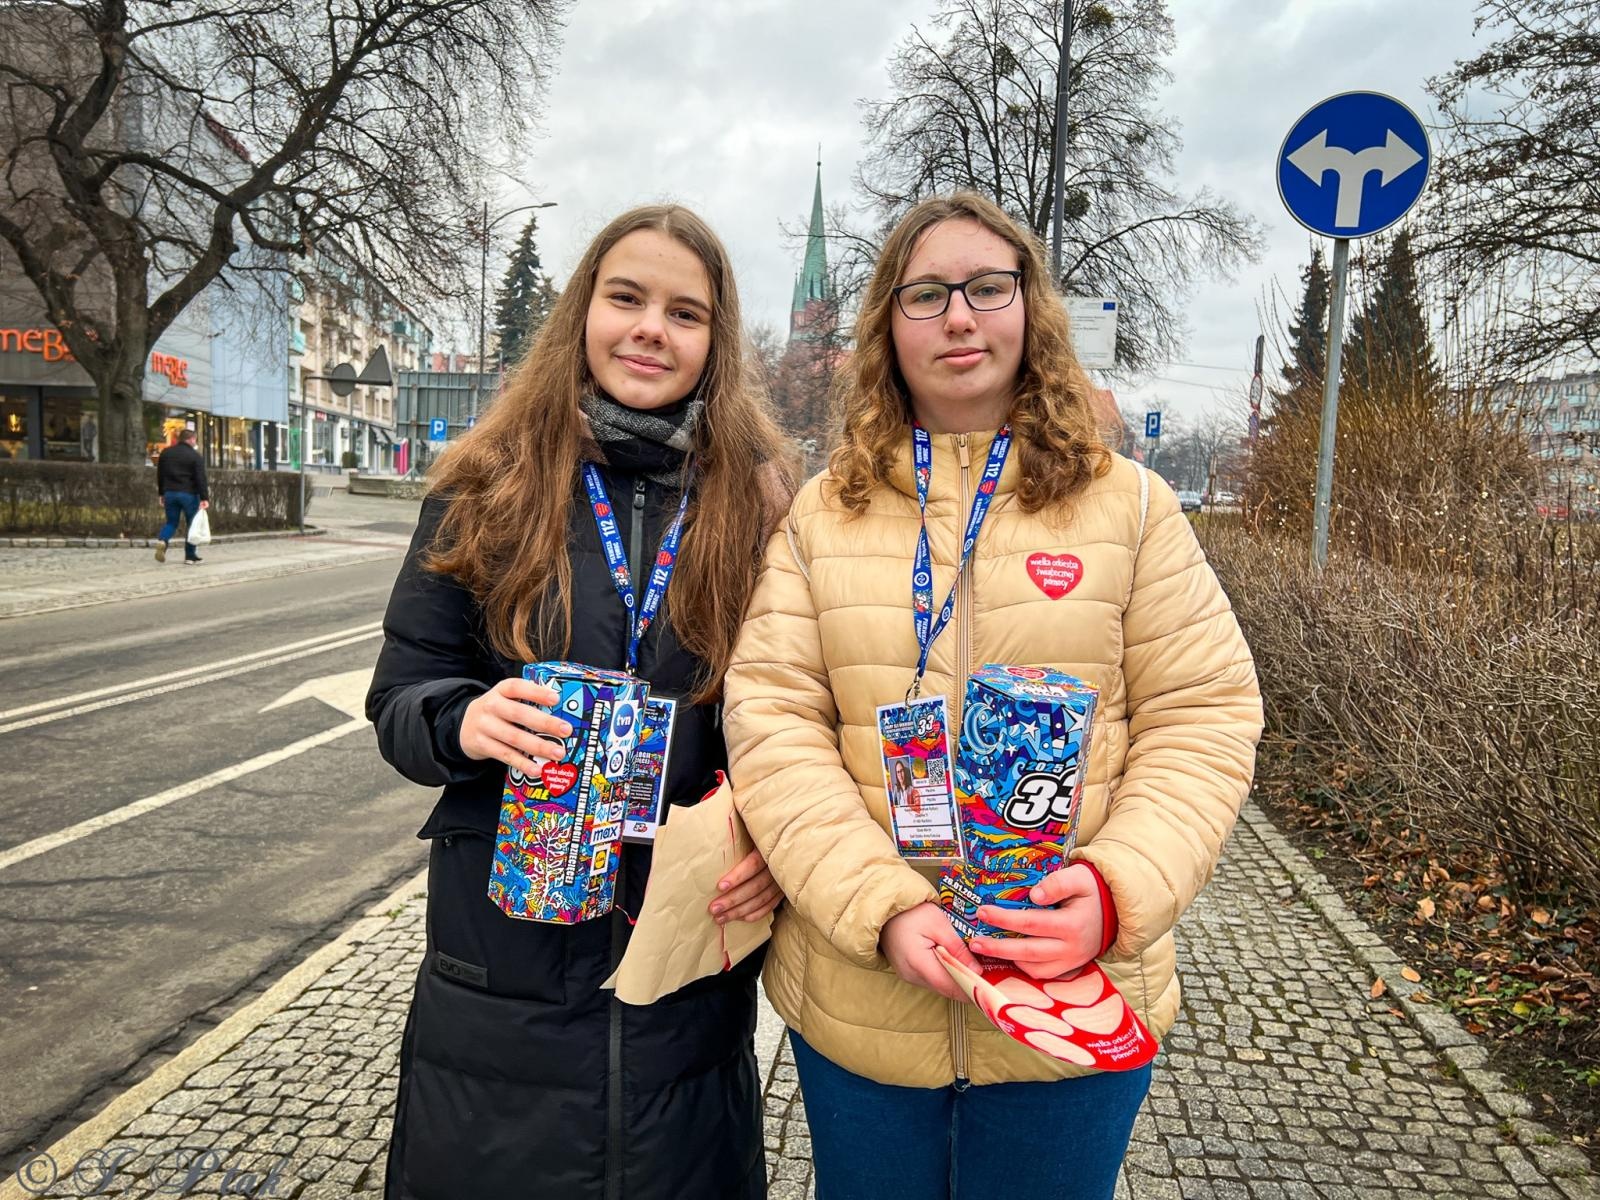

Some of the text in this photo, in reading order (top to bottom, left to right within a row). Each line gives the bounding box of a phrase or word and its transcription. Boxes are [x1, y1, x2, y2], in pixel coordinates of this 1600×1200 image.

[433, 420, 444, 435] P
[1148, 414, 1159, 435] P
[984, 463, 1001, 478] 112
[600, 519, 616, 538] 112
[652, 568, 669, 586] 112
[616, 716, 631, 726] tvn
[918, 714, 935, 735] 33
[1026, 761, 1064, 773] 2025
[593, 825, 618, 840] max
[1044, 821, 1072, 834] FIN
